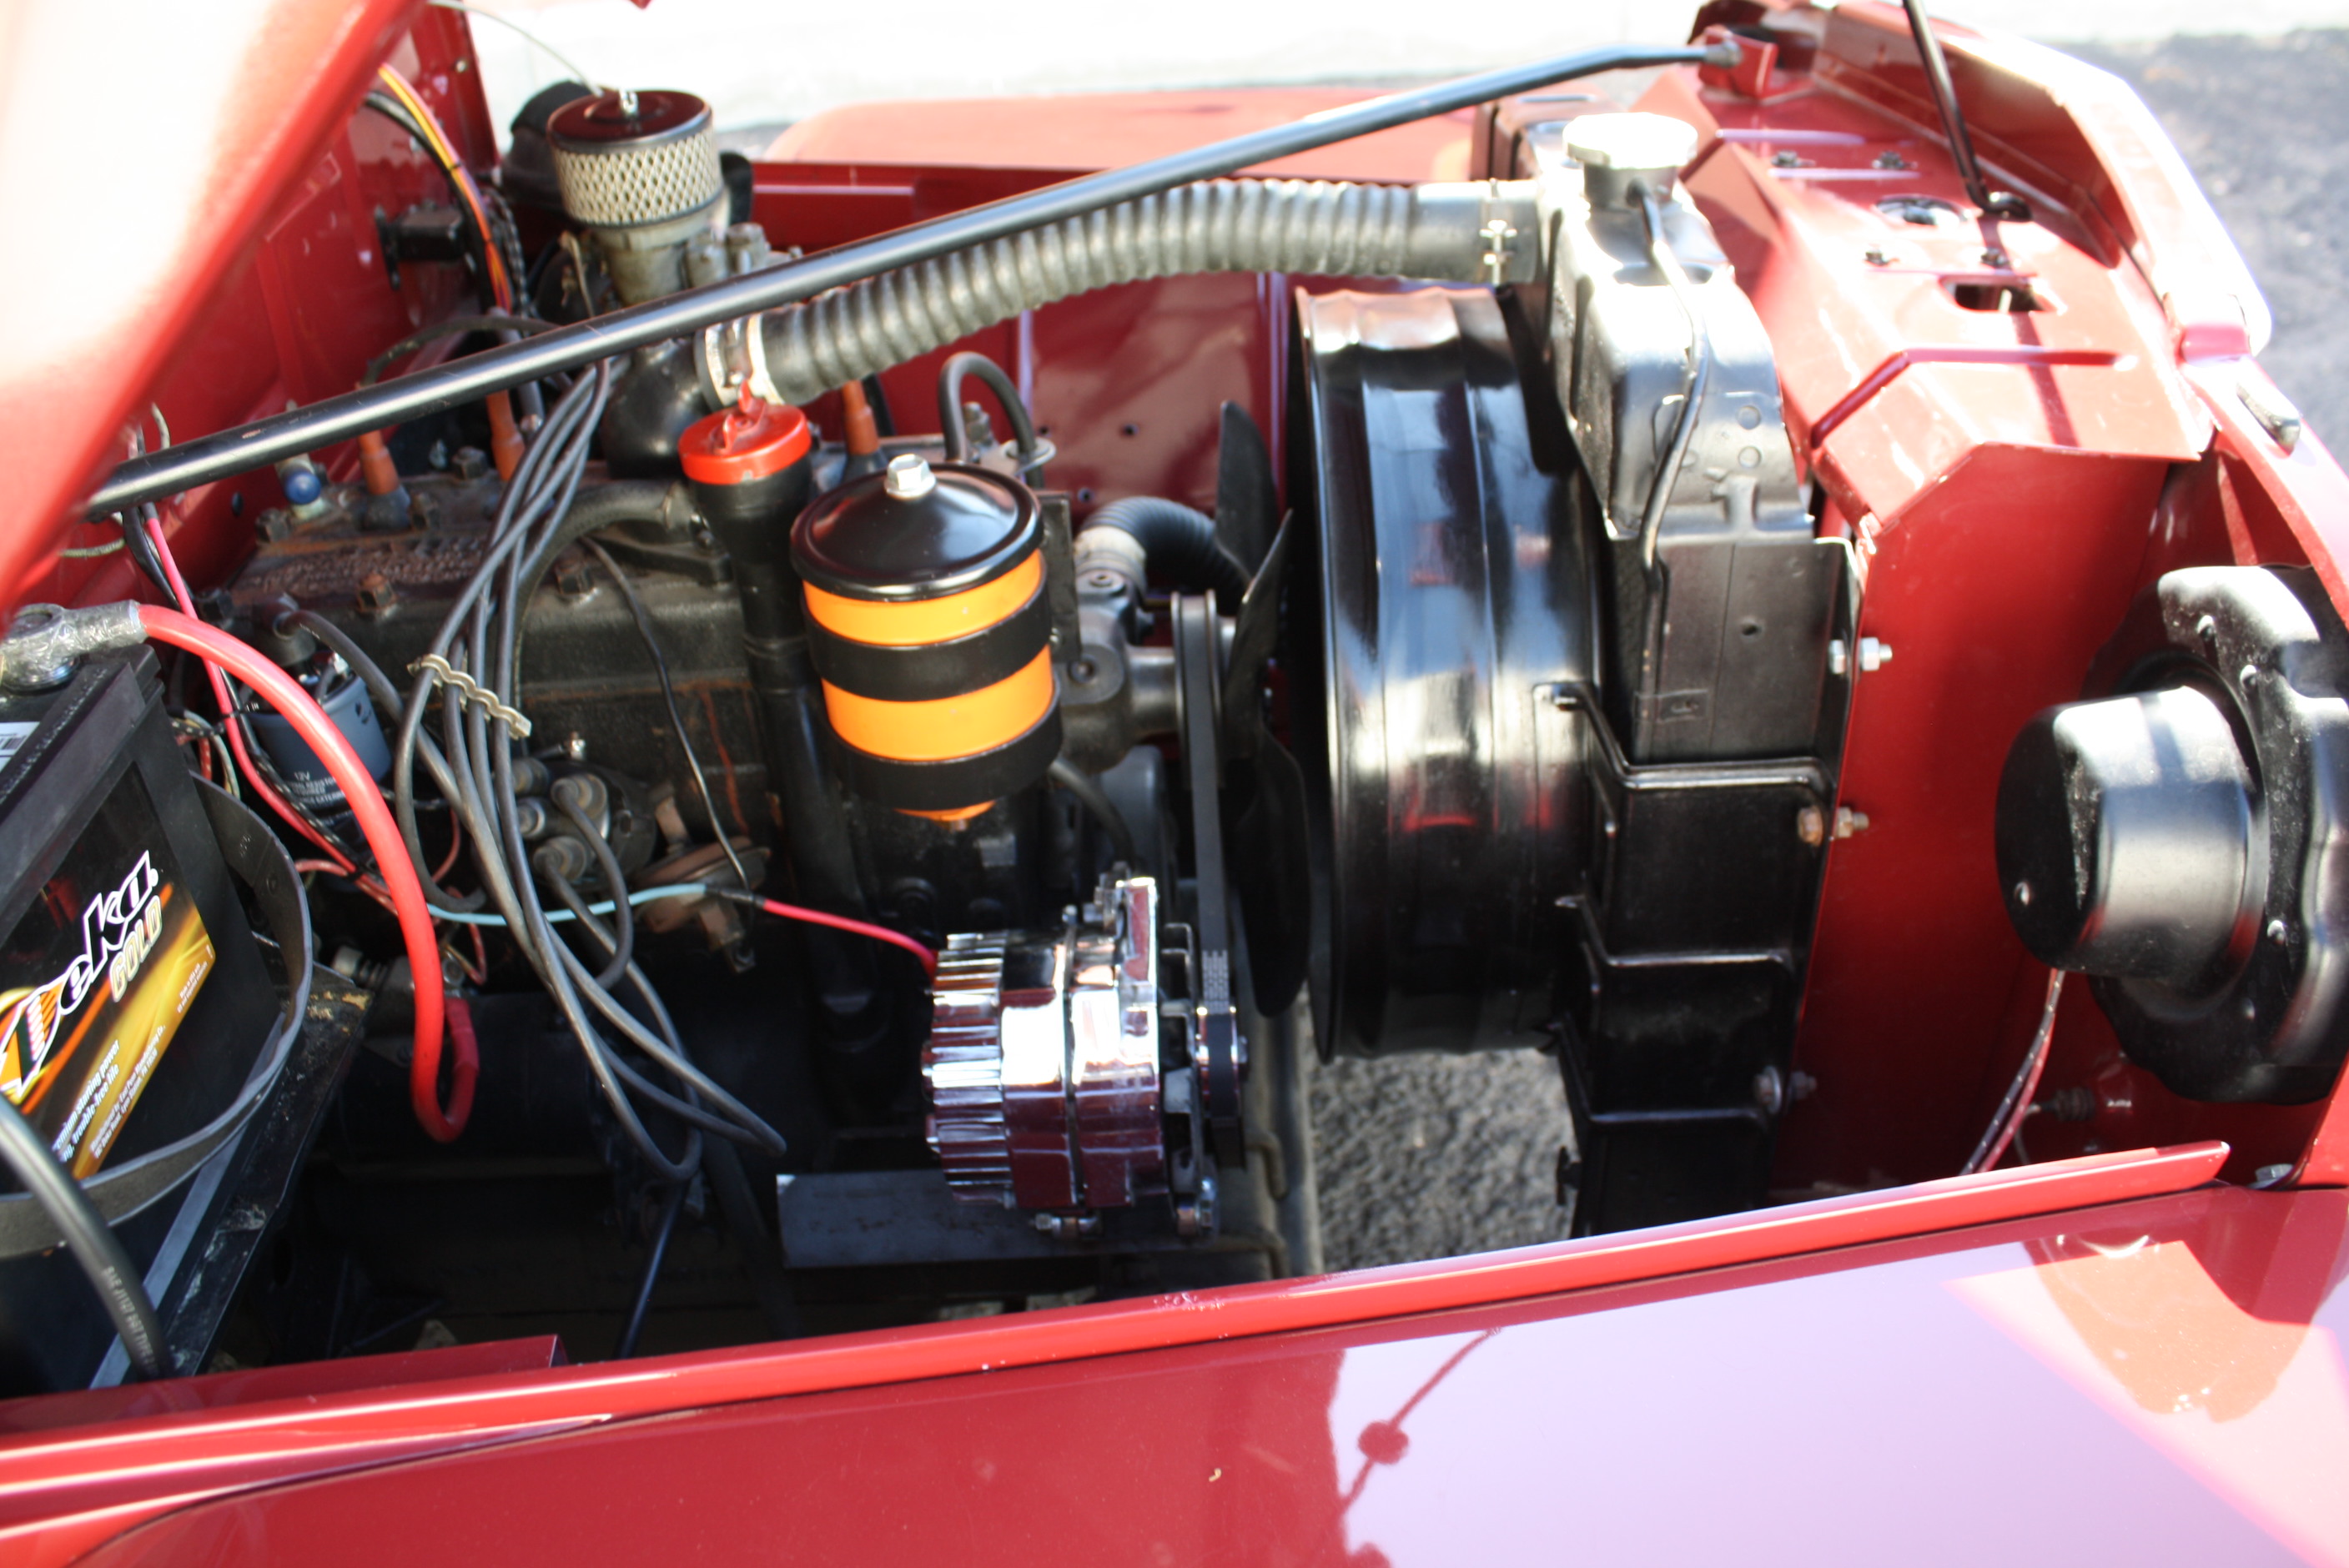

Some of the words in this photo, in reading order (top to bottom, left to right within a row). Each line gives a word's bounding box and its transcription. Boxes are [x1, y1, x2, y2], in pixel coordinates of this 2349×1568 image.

[294, 771, 310, 781] 12V
[109, 895, 163, 1003] GOLD
[75, 1072, 102, 1114] starting
[99, 1039, 119, 1078] power
[106, 1064, 119, 1085] life
